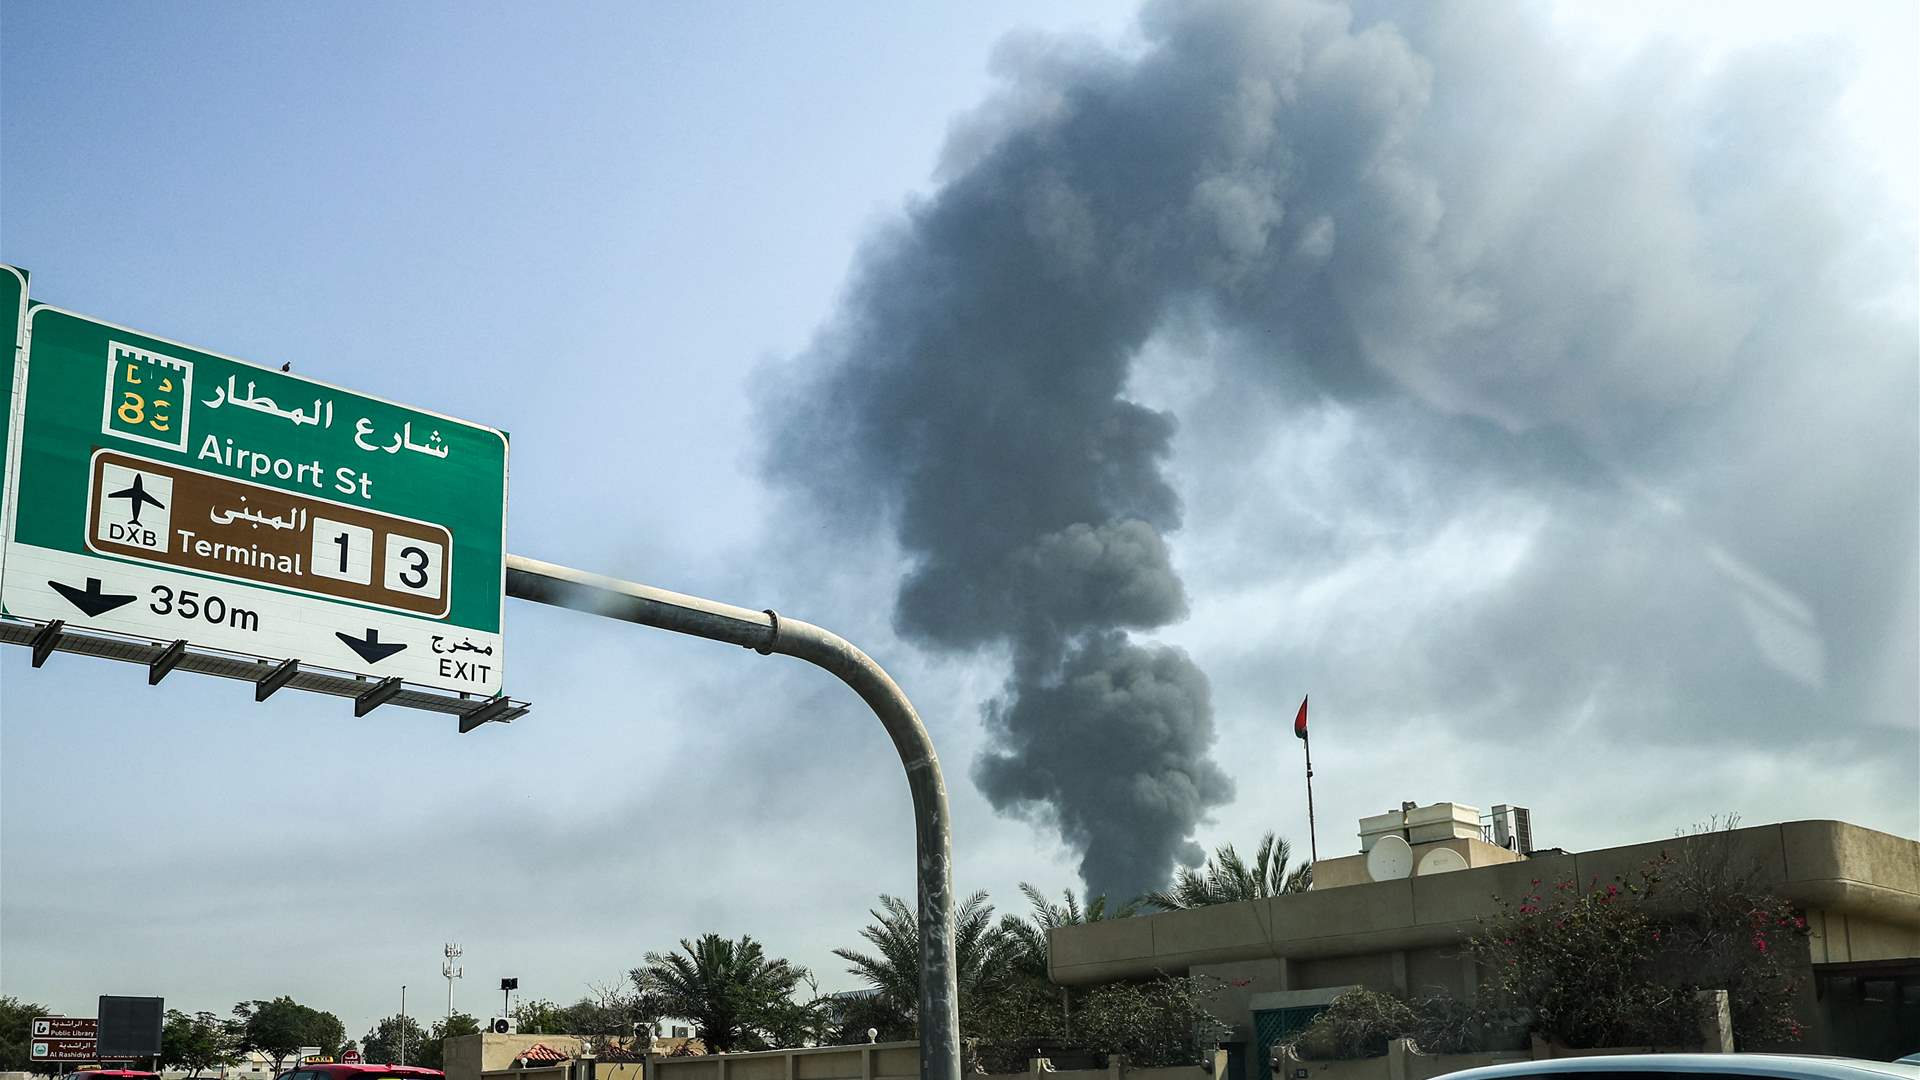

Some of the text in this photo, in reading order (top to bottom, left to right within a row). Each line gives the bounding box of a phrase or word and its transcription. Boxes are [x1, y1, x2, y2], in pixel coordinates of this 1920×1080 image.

[202, 375, 449, 459] شارع المطار
[198, 434, 373, 499] Airport St
[210, 496, 306, 533] المبنى
[109, 523, 157, 547] DXB
[178, 530, 430, 589] Terminal 1 3
[150, 585, 259, 632] 350m
[431, 632, 493, 656] مخرج
[439, 658, 492, 684] EXIT
[59, 1051, 90, 1059] Rashidiya
